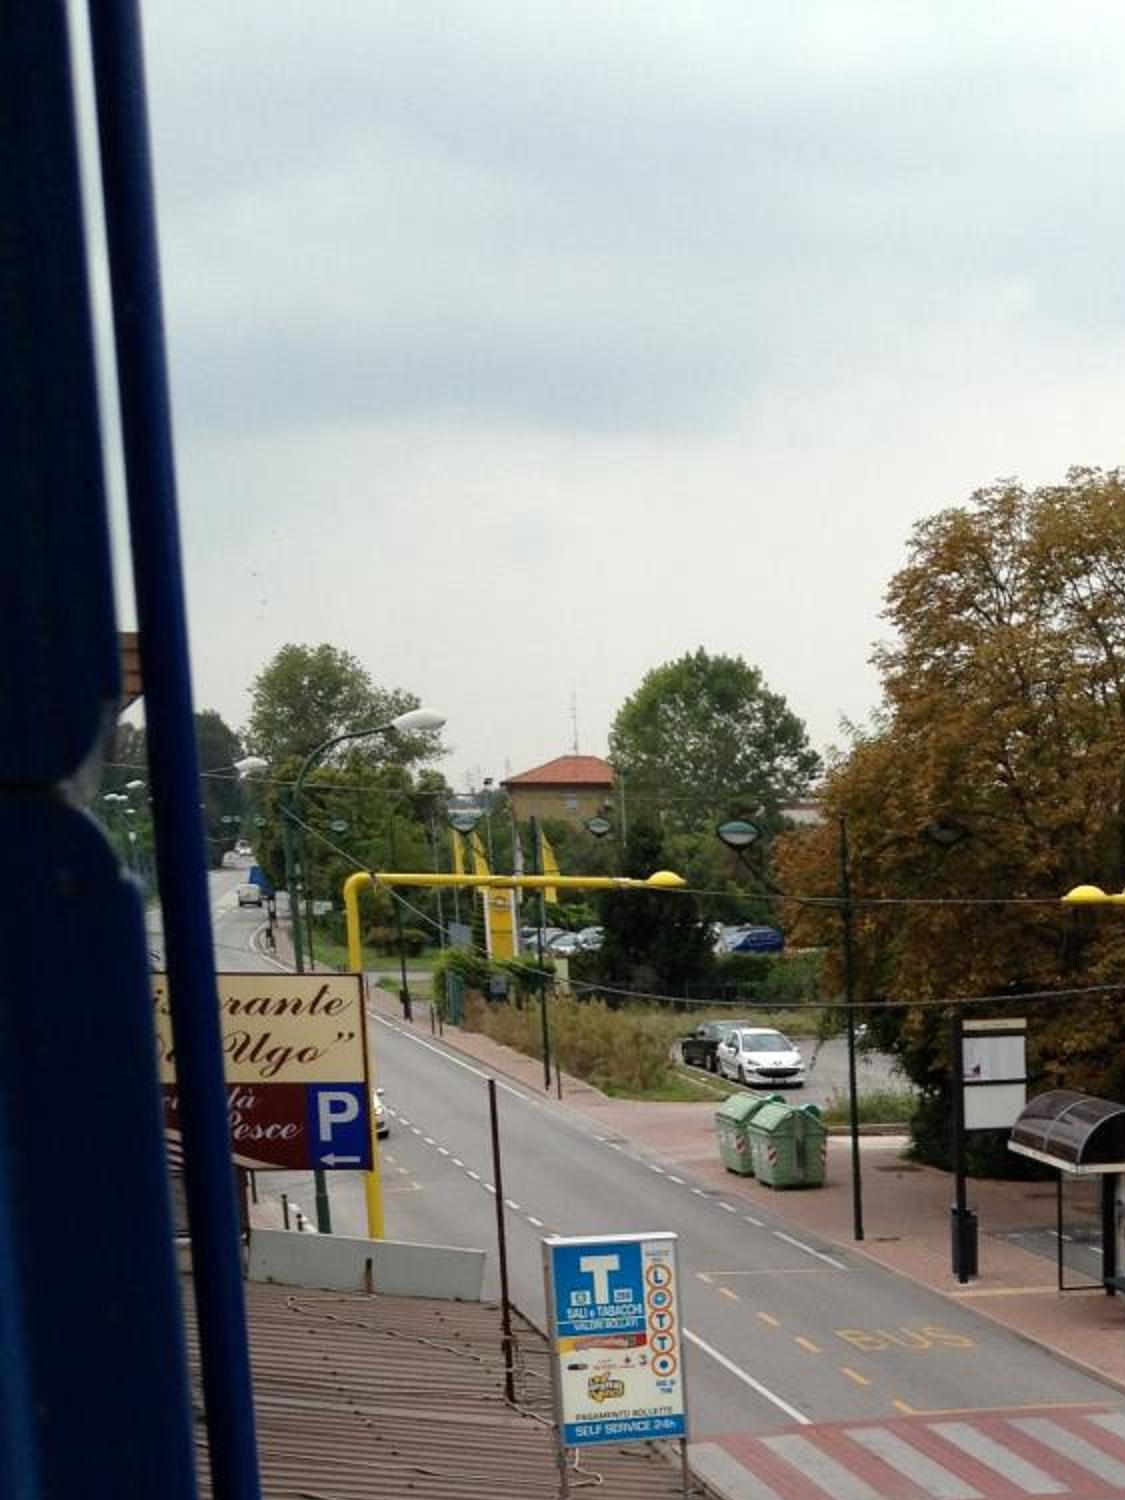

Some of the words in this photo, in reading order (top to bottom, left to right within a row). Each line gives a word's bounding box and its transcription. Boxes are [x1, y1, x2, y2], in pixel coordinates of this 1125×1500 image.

[317, 1091, 359, 1142] P
[580, 1254, 620, 1304] T
[834, 1327, 976, 1354] BUS
[575, 1425, 602, 1437] SELF
[605, 1420, 650, 1434] SERVICE
